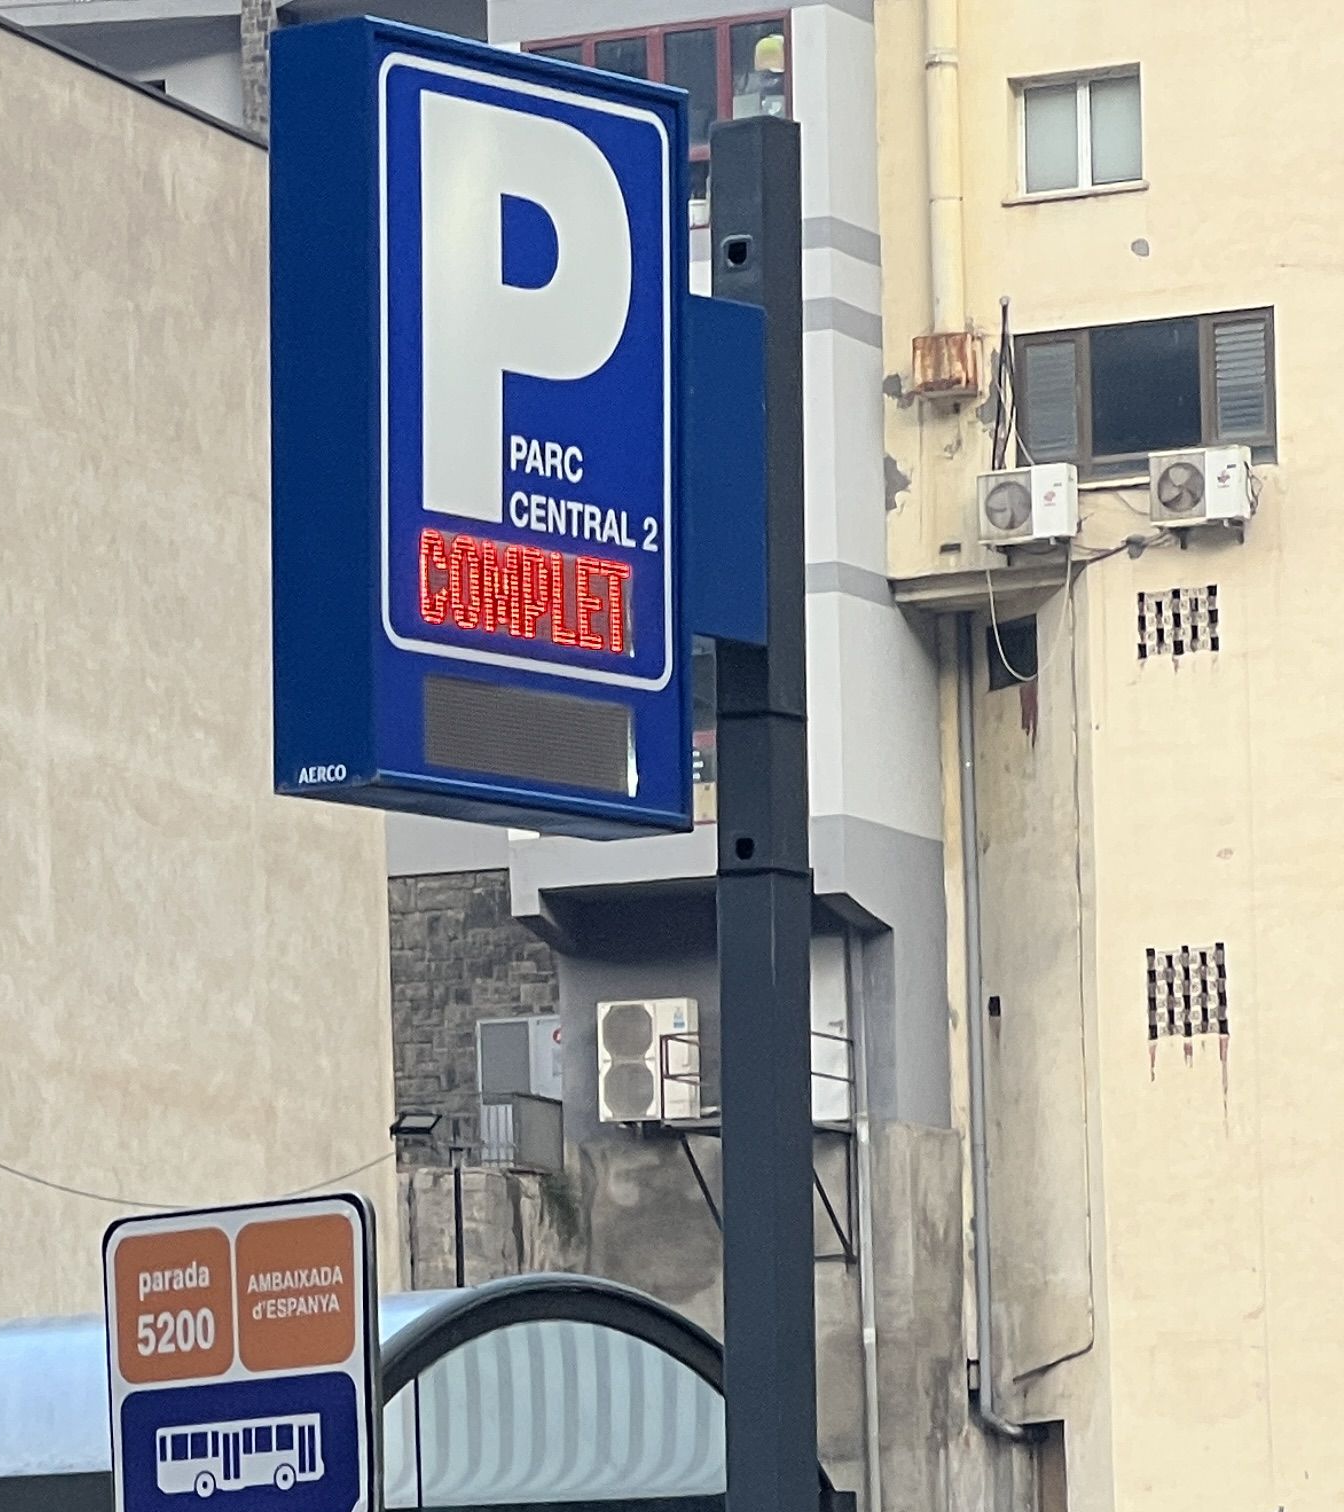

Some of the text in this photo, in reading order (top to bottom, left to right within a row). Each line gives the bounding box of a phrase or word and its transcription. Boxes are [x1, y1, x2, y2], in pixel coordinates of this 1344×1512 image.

[420, 88, 633, 524] P
[509, 435, 583, 483] PARC
[509, 491, 658, 551] CENTRAL 2
[419, 528, 631, 654] COMPLET
[298, 764, 347, 784] AERCO
[138, 1261, 210, 1301] parada
[247, 1265, 343, 1294] AMBAIXADA
[252, 1293, 341, 1320] d'ESPANYA
[137, 1307, 215, 1356] 5200
